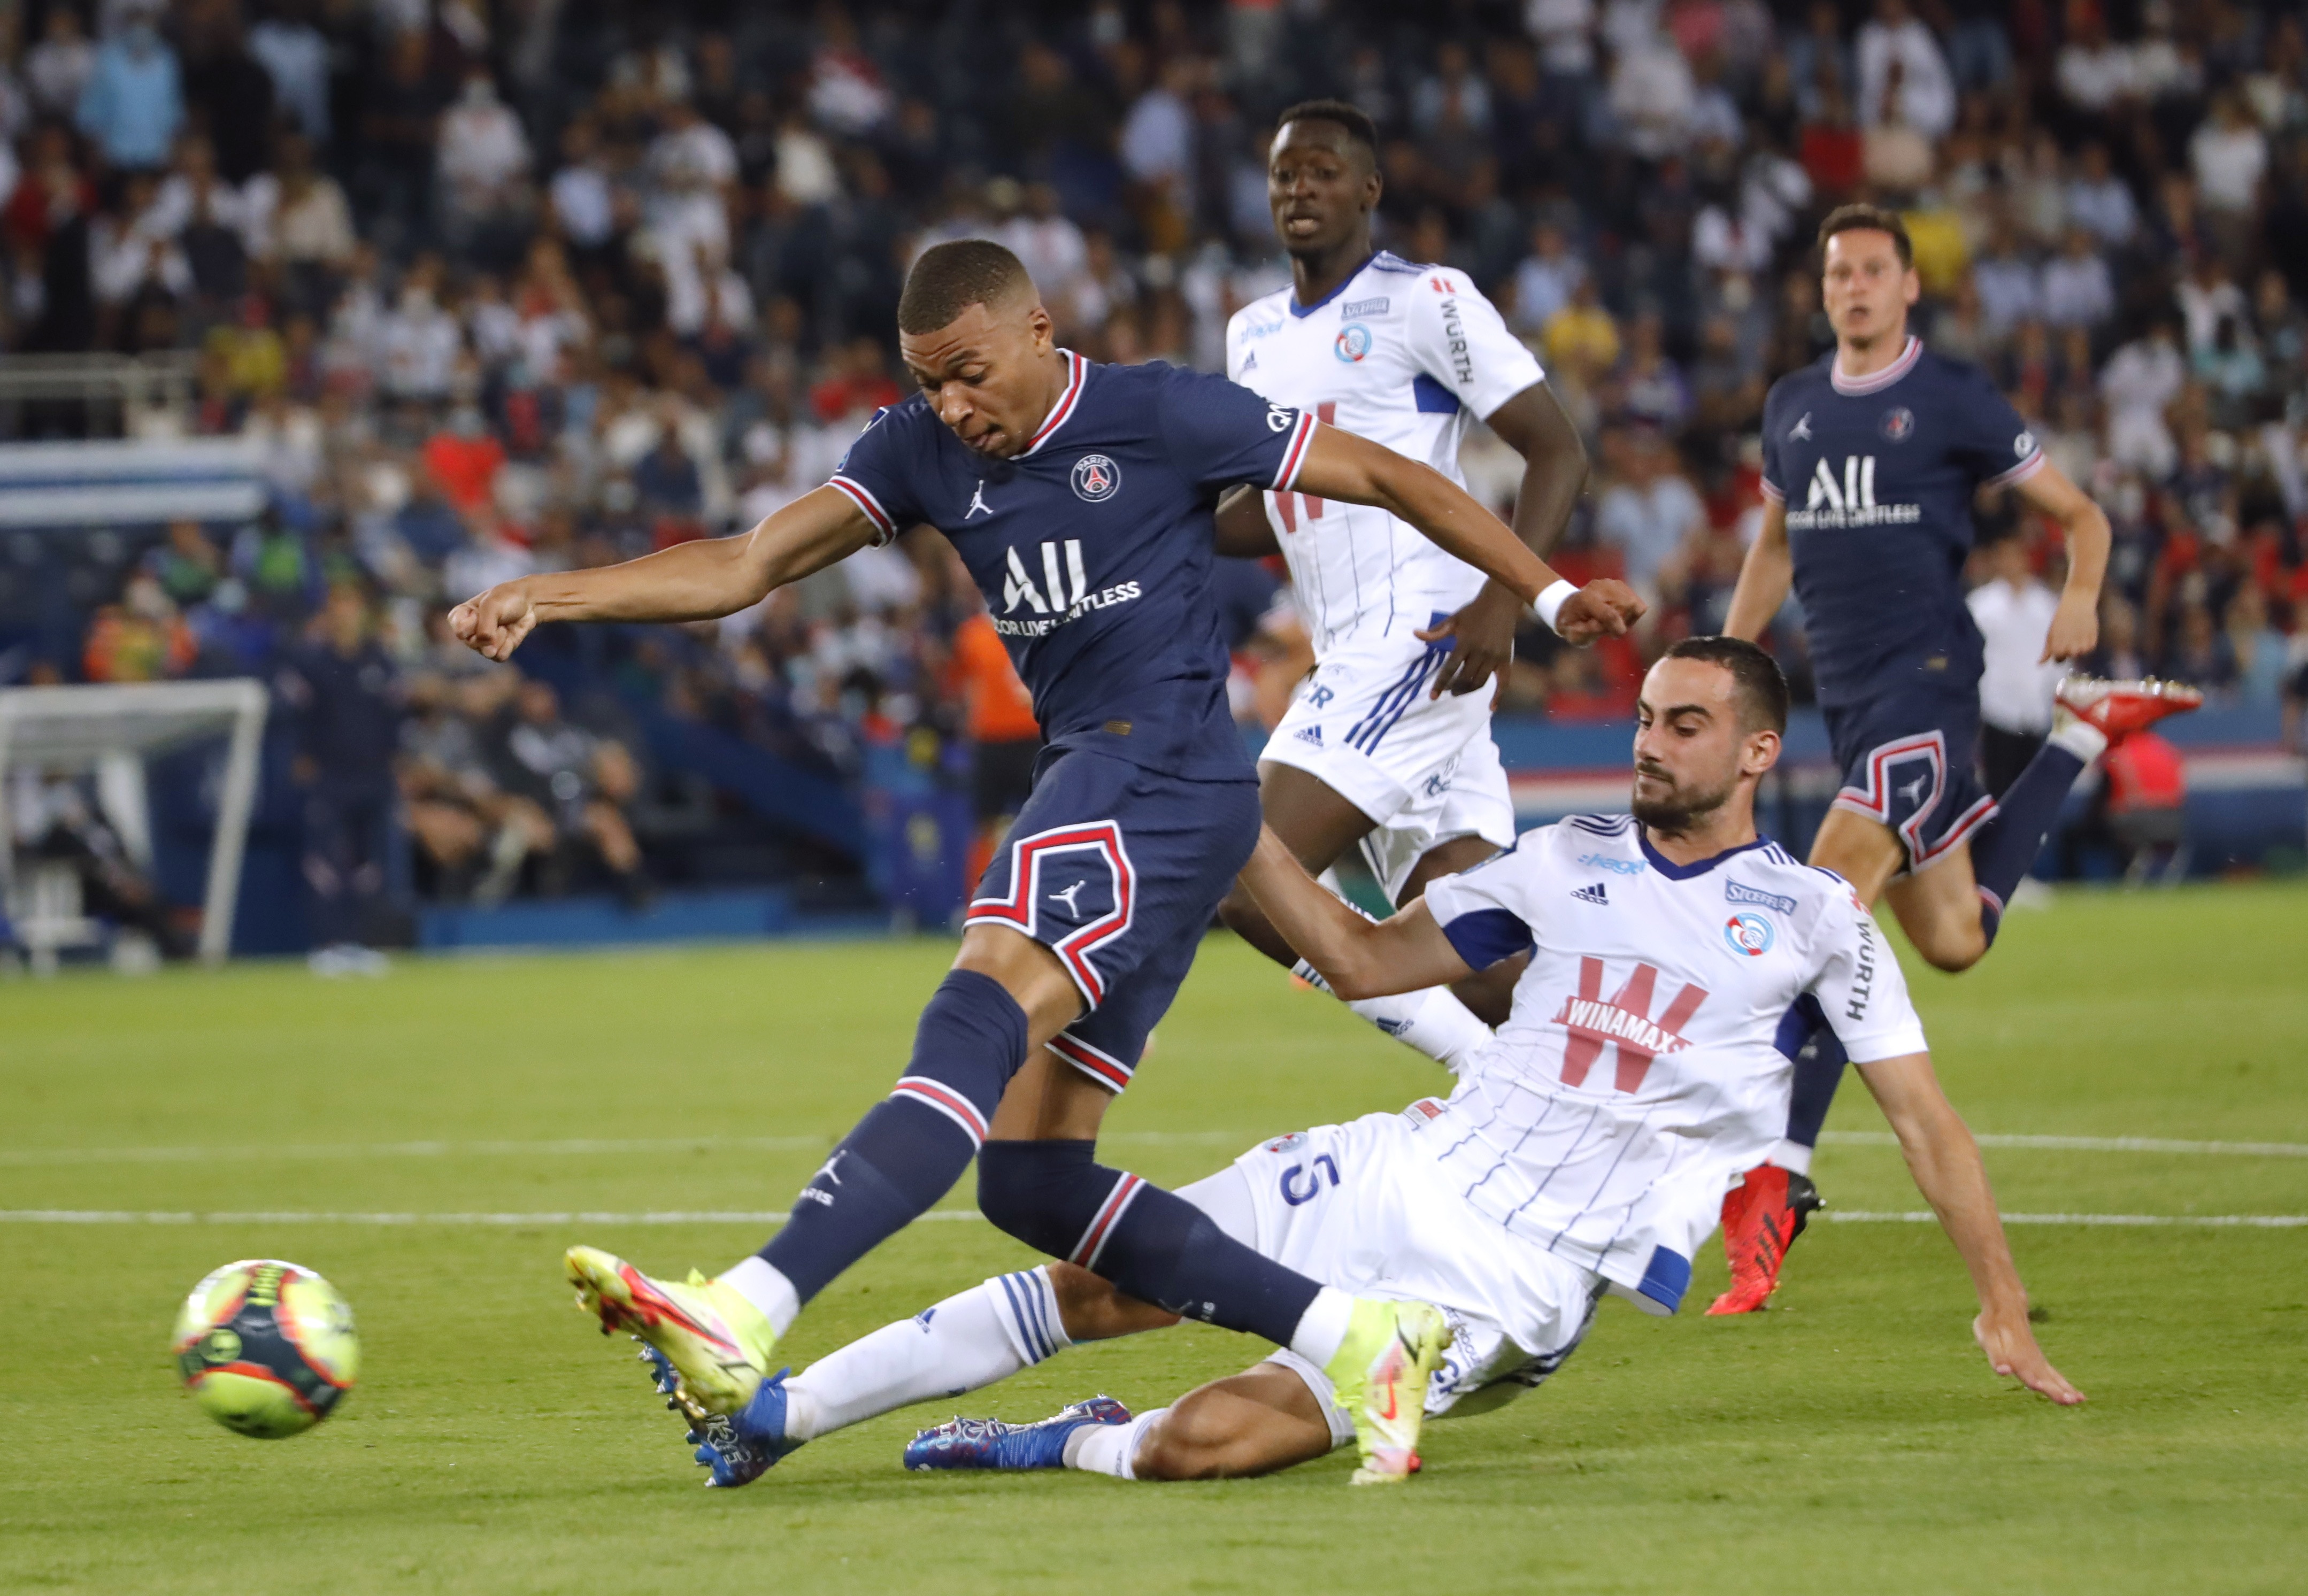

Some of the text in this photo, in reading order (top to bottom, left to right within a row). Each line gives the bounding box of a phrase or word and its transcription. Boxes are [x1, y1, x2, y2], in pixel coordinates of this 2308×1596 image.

[1440, 298, 1474, 384] WÜRTH
[1076, 457, 1109, 471] PARIS
[1845, 922, 1875, 1021] WÜRTH
[1566, 998, 1677, 1054] WINAMAX
[1280, 1152, 1341, 1206] 5
